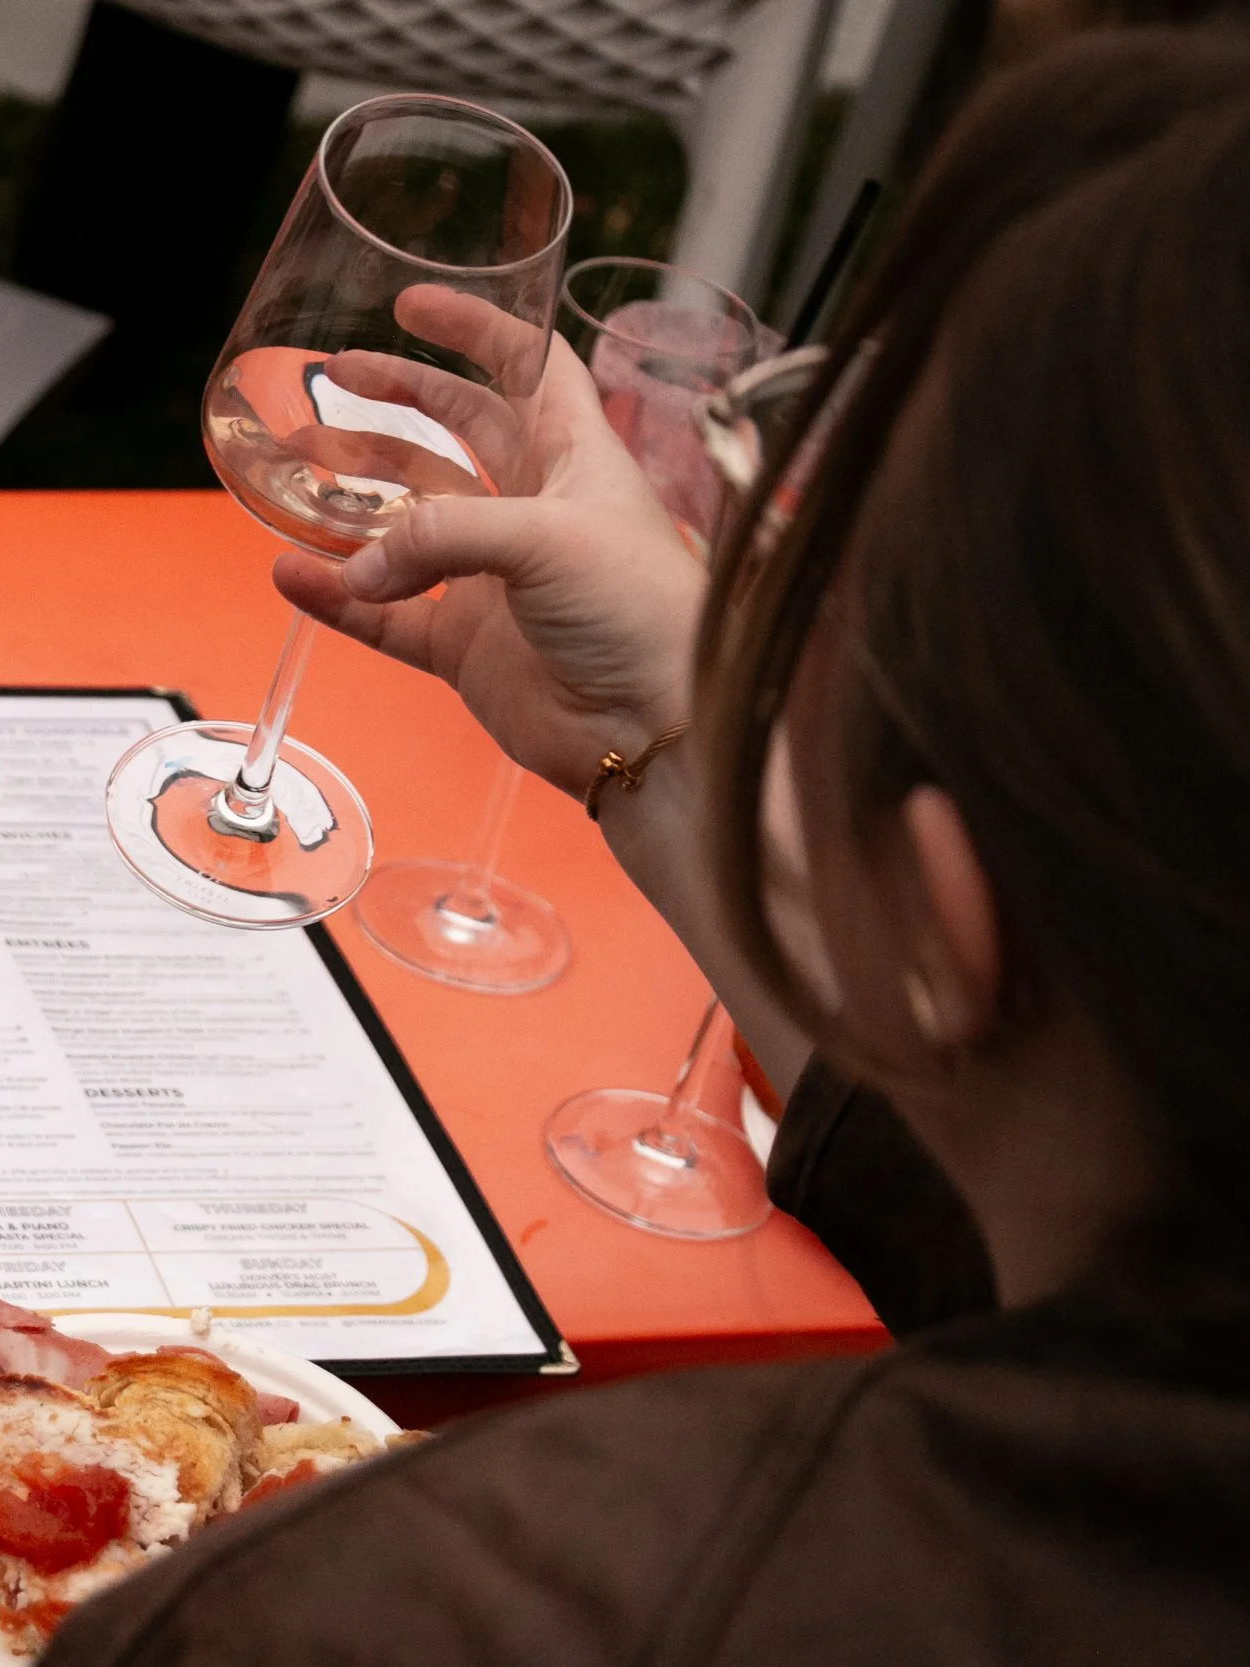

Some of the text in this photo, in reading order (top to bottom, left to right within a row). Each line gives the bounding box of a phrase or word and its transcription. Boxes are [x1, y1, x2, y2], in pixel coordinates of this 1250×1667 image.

[83, 1087, 184, 1099] DESSERTS
[199, 1202, 308, 1215] THURSDAY
[21, 1221, 70, 1231] PIANO
[239, 1257, 323, 1270] SUNDAY
[56, 1279, 110, 1289] LUNCH
